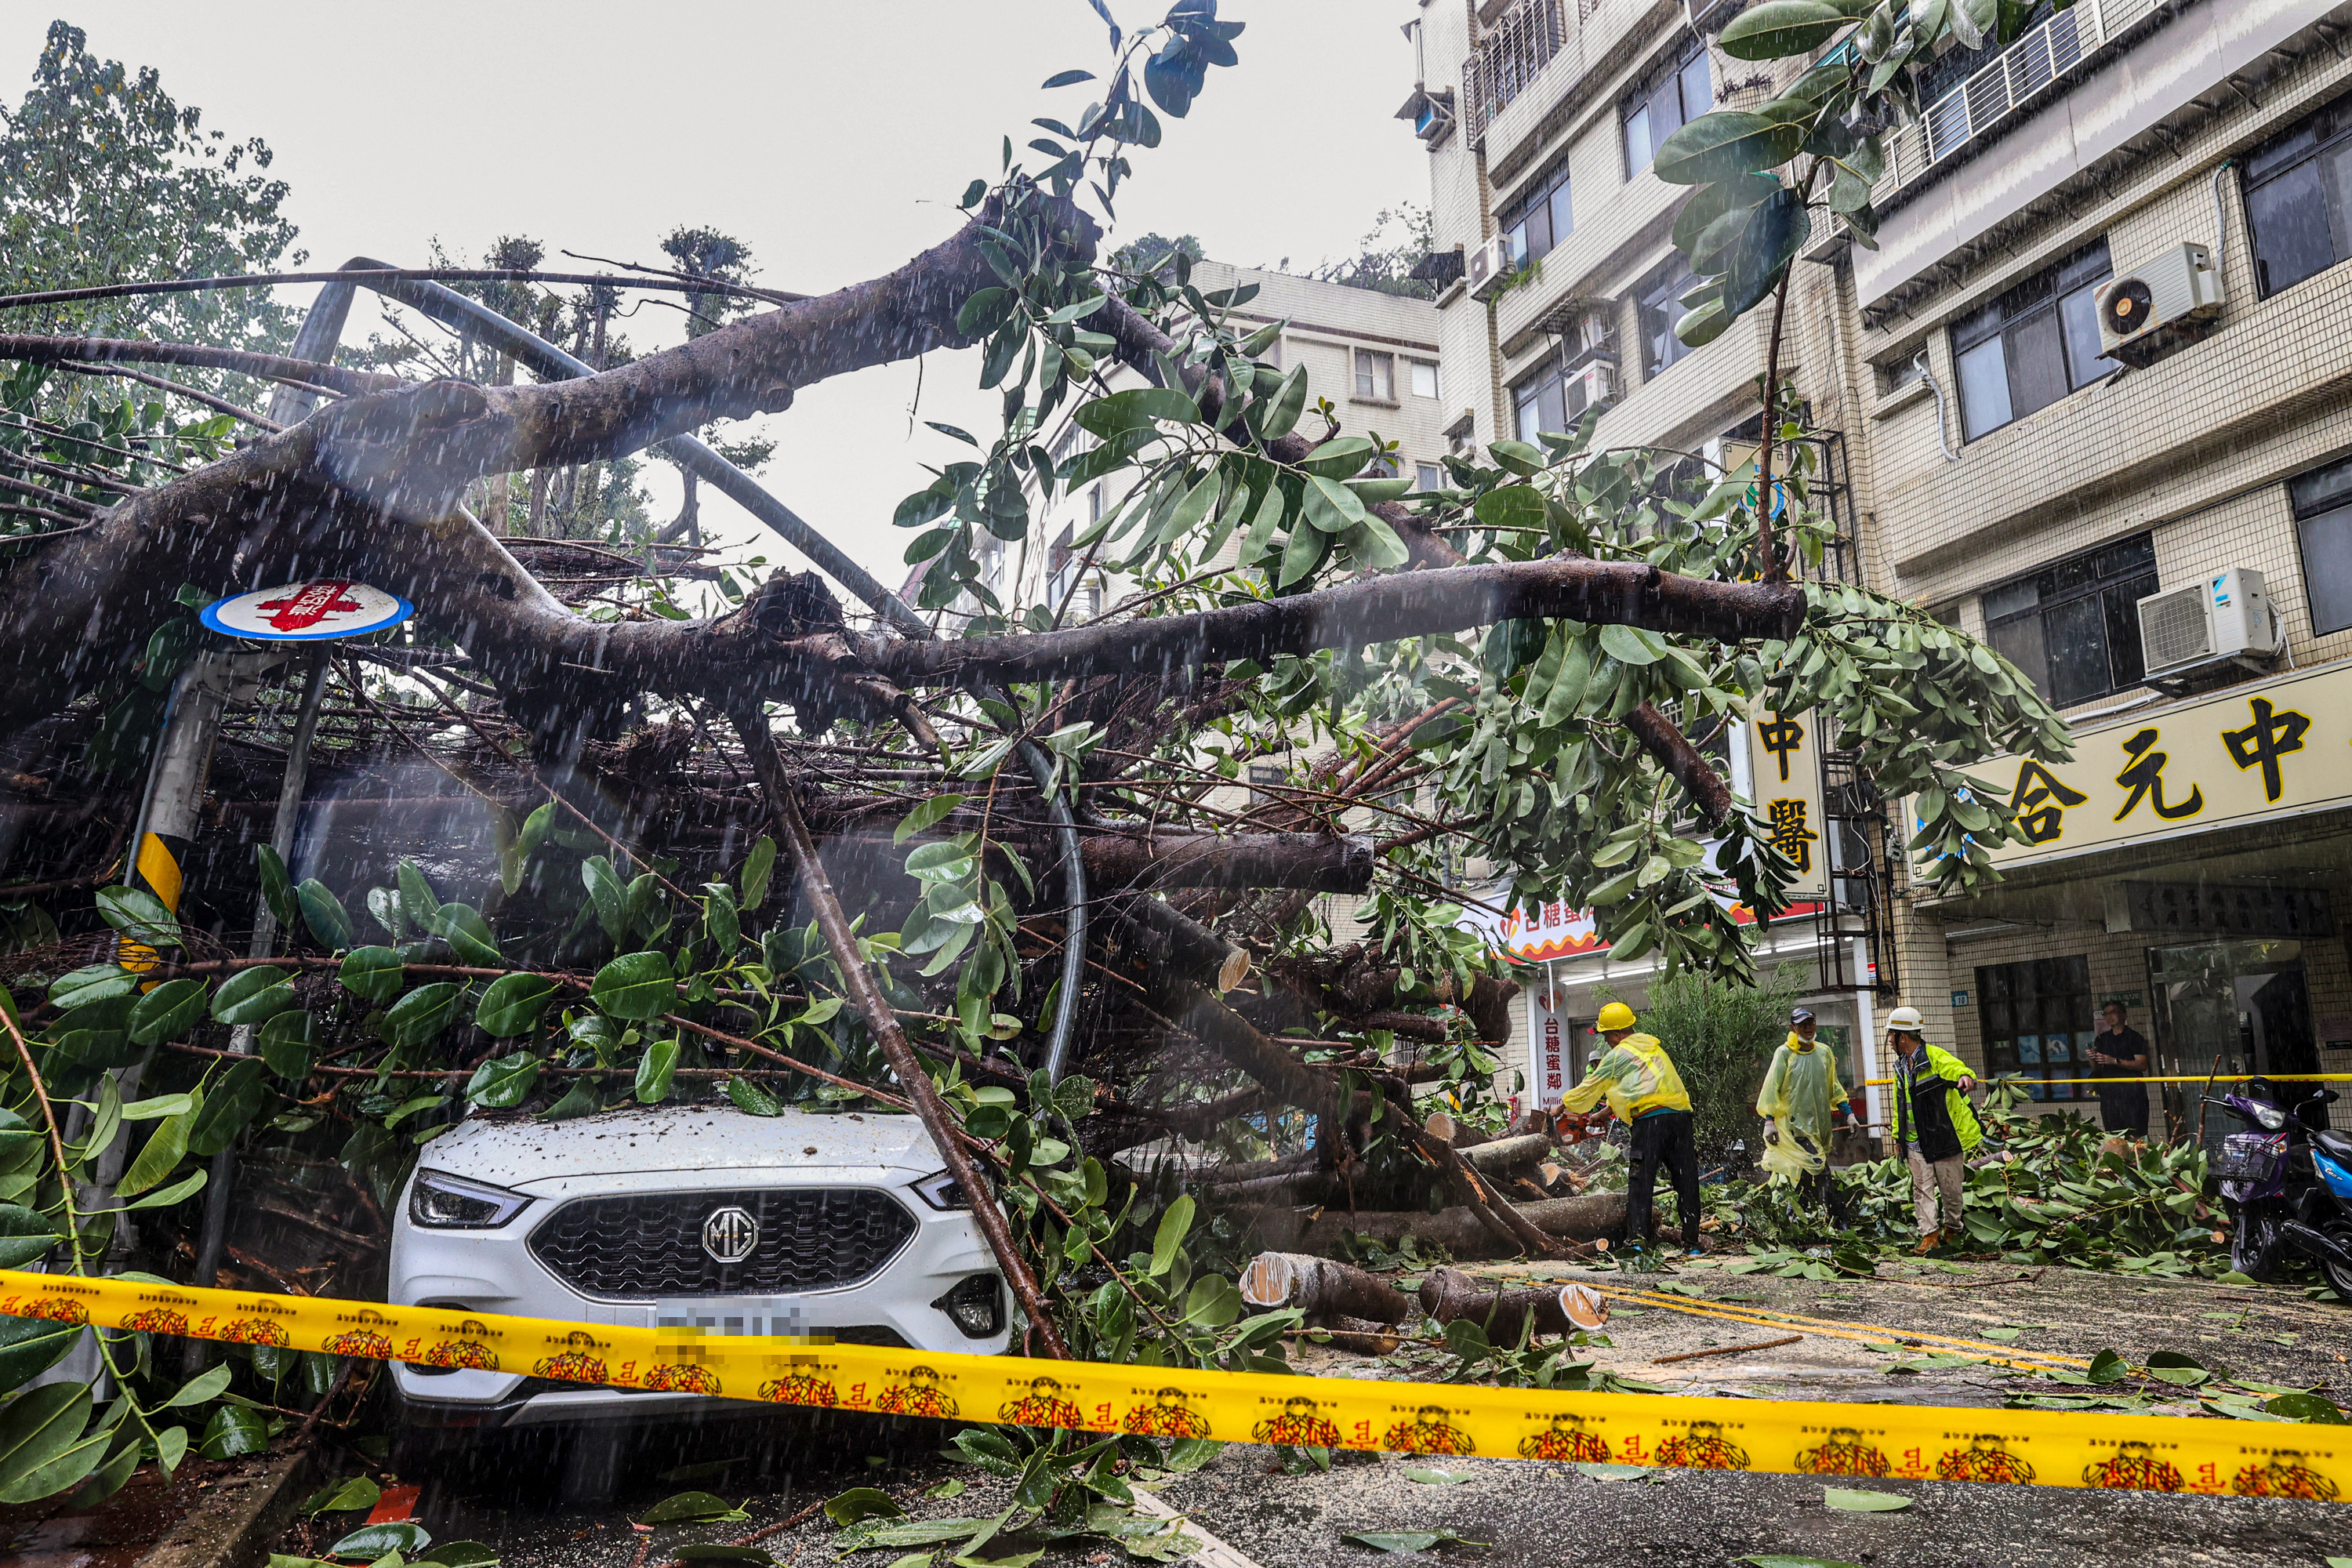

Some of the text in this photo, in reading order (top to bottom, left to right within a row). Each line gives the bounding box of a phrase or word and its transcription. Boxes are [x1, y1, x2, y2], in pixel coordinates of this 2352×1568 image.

[287, 584, 338, 616] 消防栓
[2009, 695, 2312, 846] 合元中
[1544, 1017, 1563, 1091] 台糖蜜鄰
[707, 1212, 754, 1258] MG
